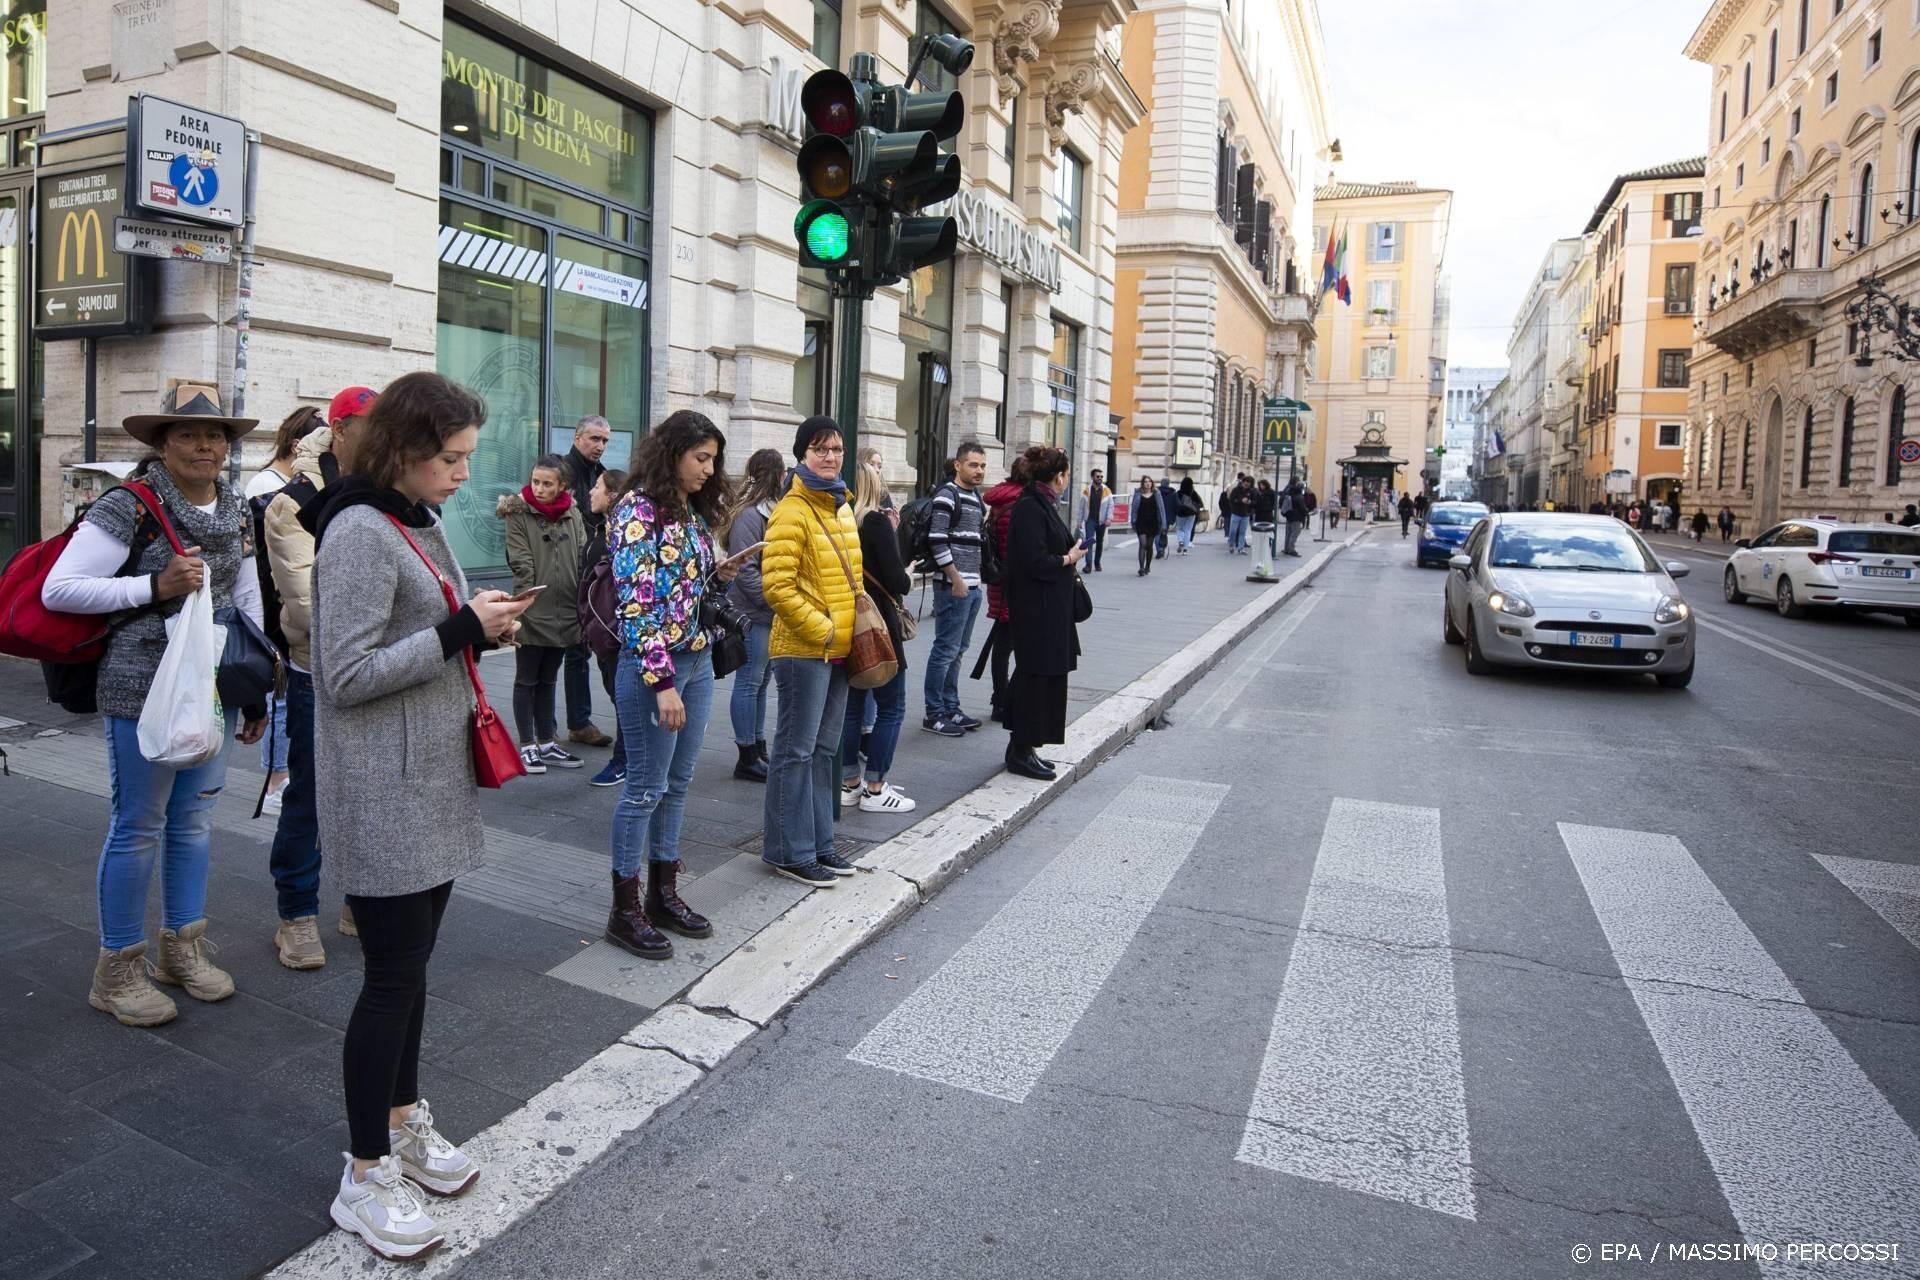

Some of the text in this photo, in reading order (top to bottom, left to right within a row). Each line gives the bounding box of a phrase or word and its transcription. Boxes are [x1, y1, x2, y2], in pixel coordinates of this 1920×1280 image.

[128, 11, 157, 30] TREVI
[445, 50, 635, 157] MONTE DEI PASCHI
[180, 114, 210, 134] AREA
[165, 128, 222, 155] PEDONALE
[504, 107, 592, 166] DI SIENA
[58, 174, 107, 193] FONTANA DI TREVI
[48, 197, 58, 209] VIA
[58, 194, 74, 208] DELLE
[943, 190, 1000, 257] ASCHI
[171, 229, 225, 245] attrezzato
[77, 294, 117, 311] SIAMO QUI
